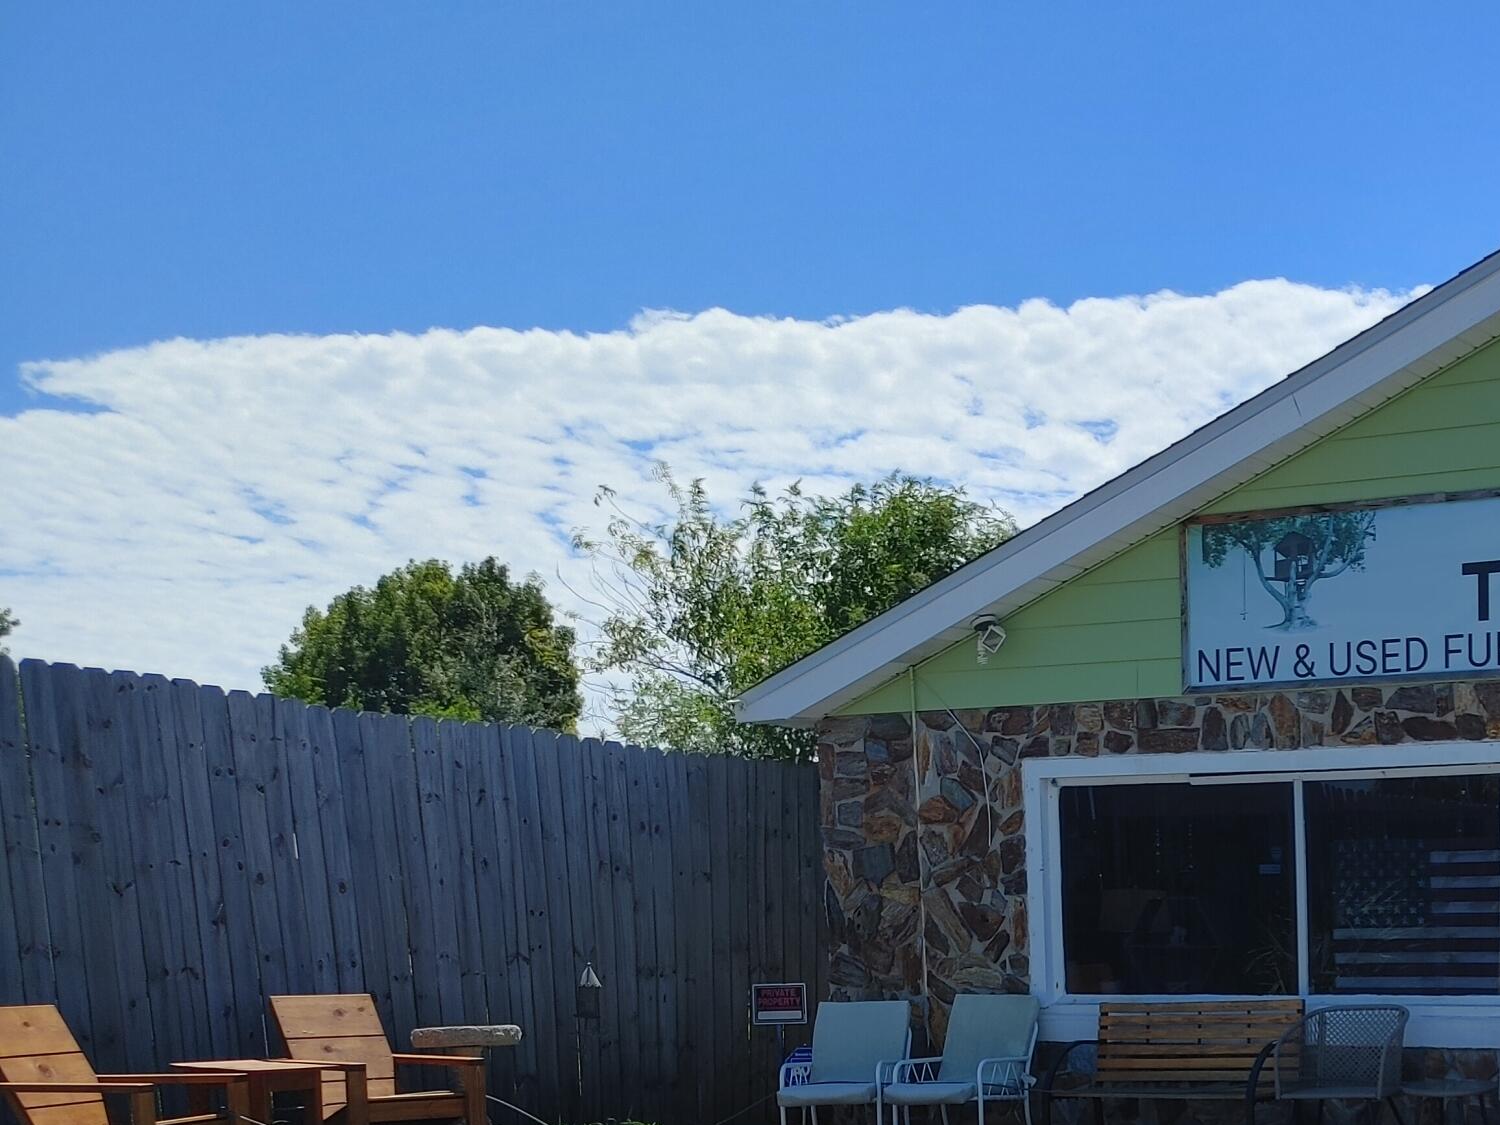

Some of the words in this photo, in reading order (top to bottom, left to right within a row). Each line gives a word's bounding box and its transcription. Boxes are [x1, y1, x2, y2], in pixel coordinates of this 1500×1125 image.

[1198, 645, 1281, 683] NEW
[1293, 642, 1317, 679] &
[1328, 636, 1429, 676] USED
[760, 988, 797, 997] PRIVATE
[758, 997, 801, 1006] PROPERTY
